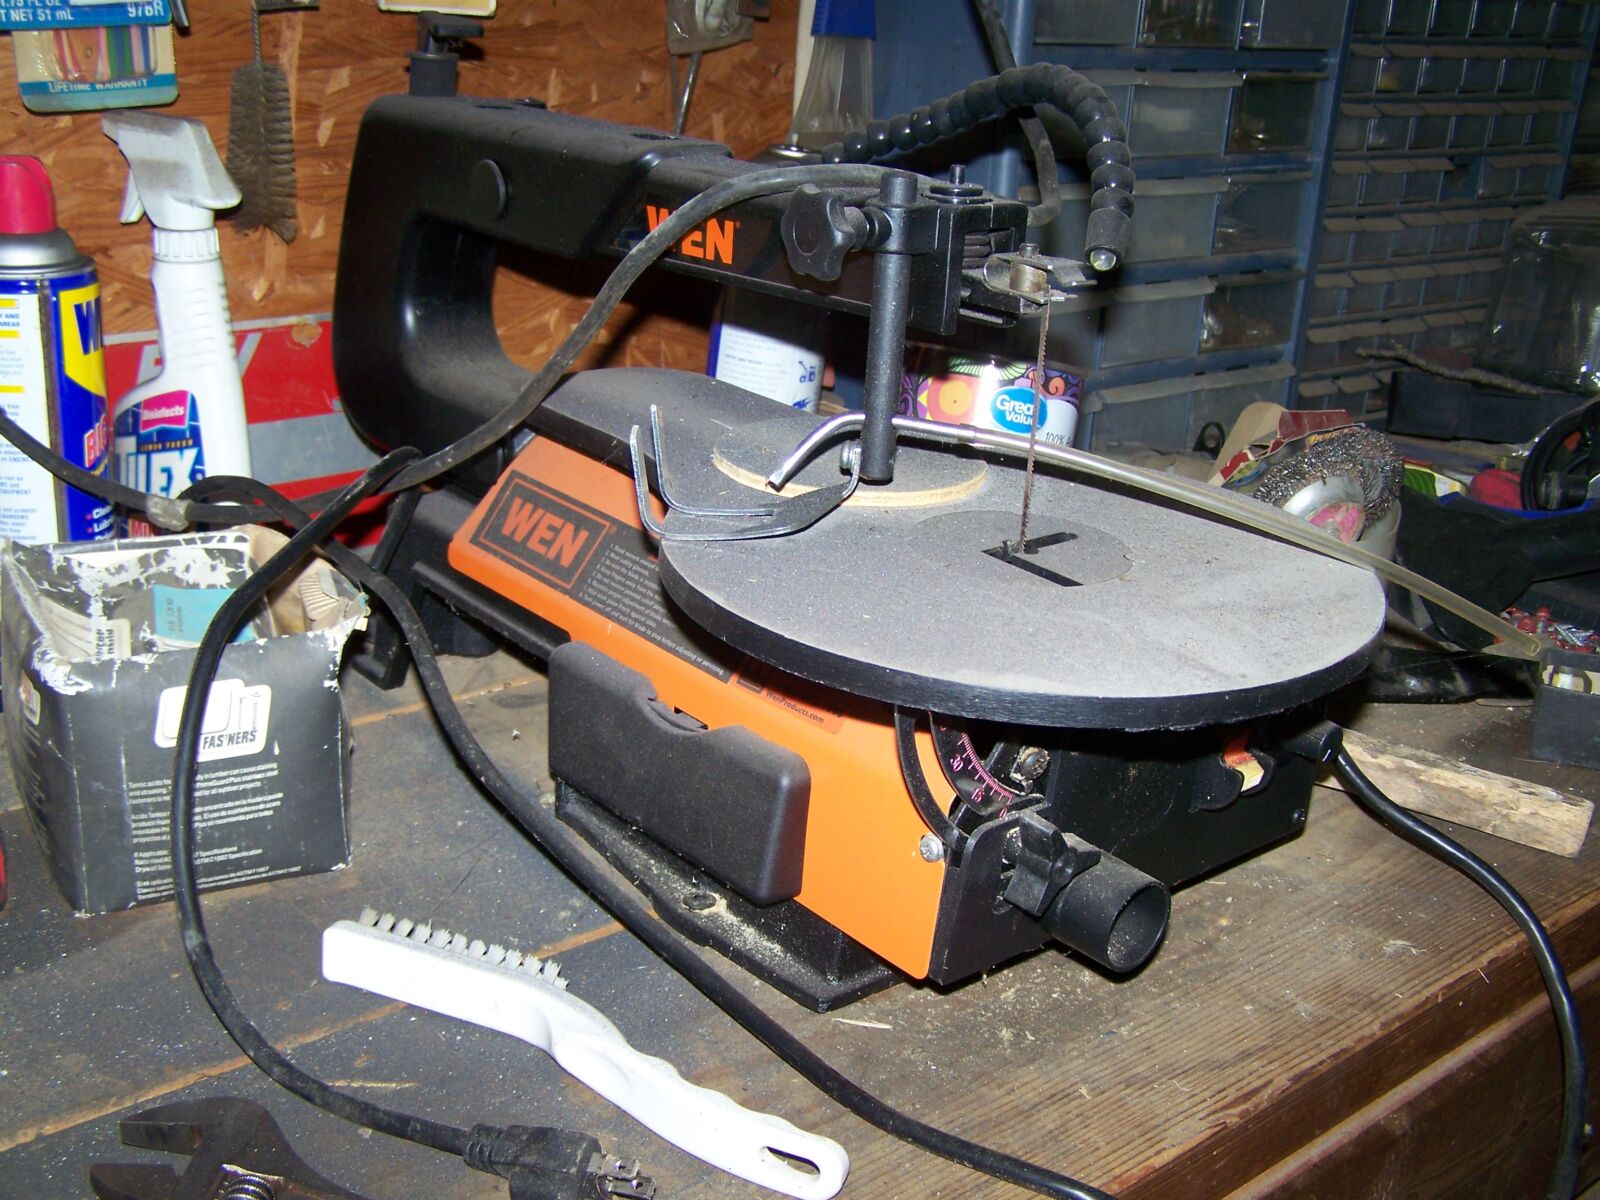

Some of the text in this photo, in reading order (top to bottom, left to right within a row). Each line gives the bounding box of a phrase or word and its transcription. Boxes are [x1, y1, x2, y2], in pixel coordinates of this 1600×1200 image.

[10, 9, 33, 21] NET
[37, 9, 52, 21] 51
[56, 8, 75, 20] mL
[996, 394, 1036, 417] Grea
[501, 496, 590, 569] WEN
[950, 754, 964, 772] 30
